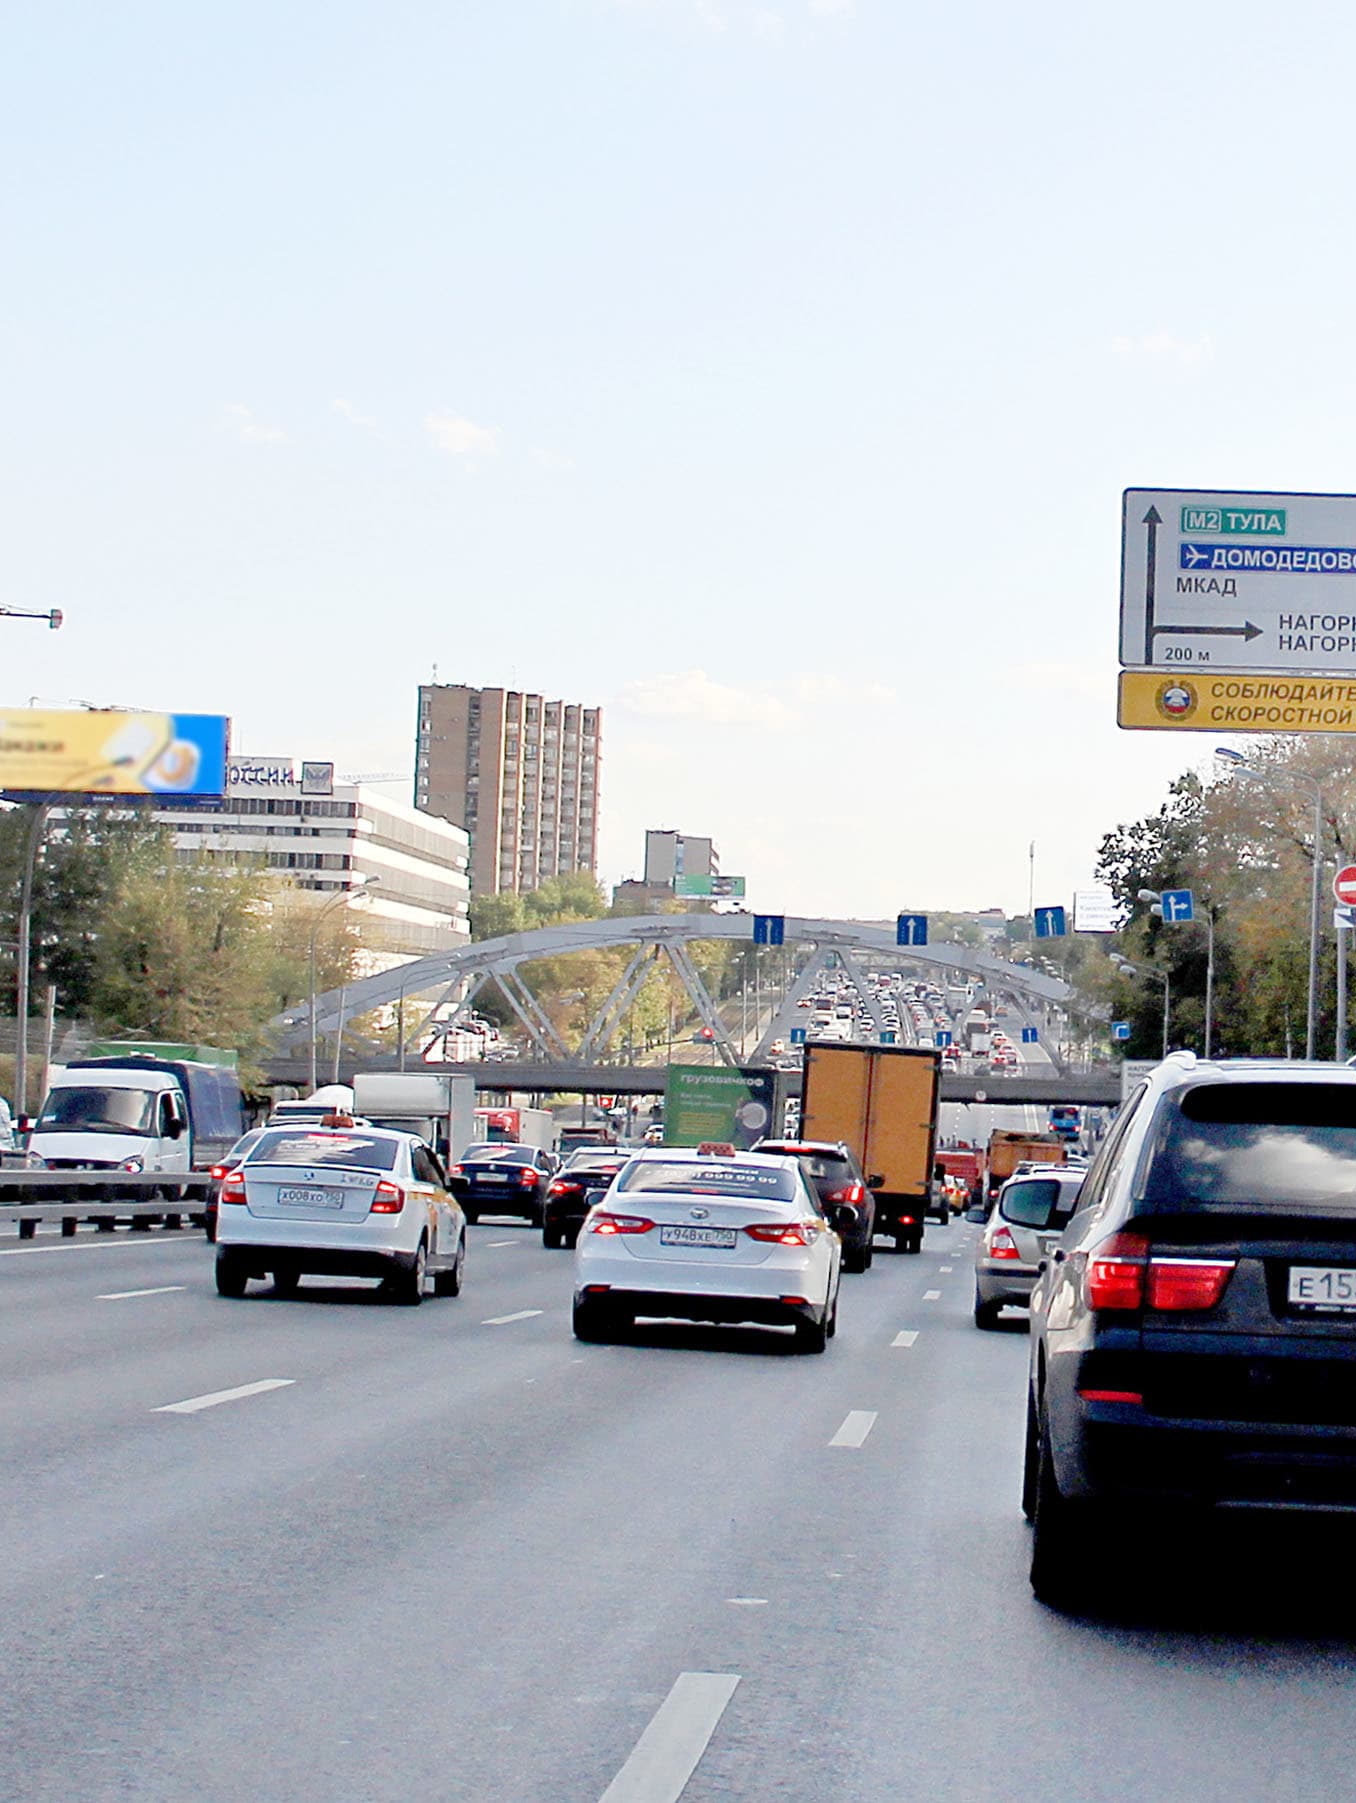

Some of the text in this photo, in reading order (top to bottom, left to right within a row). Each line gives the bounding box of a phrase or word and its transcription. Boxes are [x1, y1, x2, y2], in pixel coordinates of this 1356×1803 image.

[1188, 511, 1282, 532] М2 ТУЛА
[1176, 576, 1237, 597] МКАД
[1165, 647, 1192, 661] 200
[1210, 704, 1353, 724] СКОРОСТНОЙ
[225, 764, 294, 787] ОССИИ
